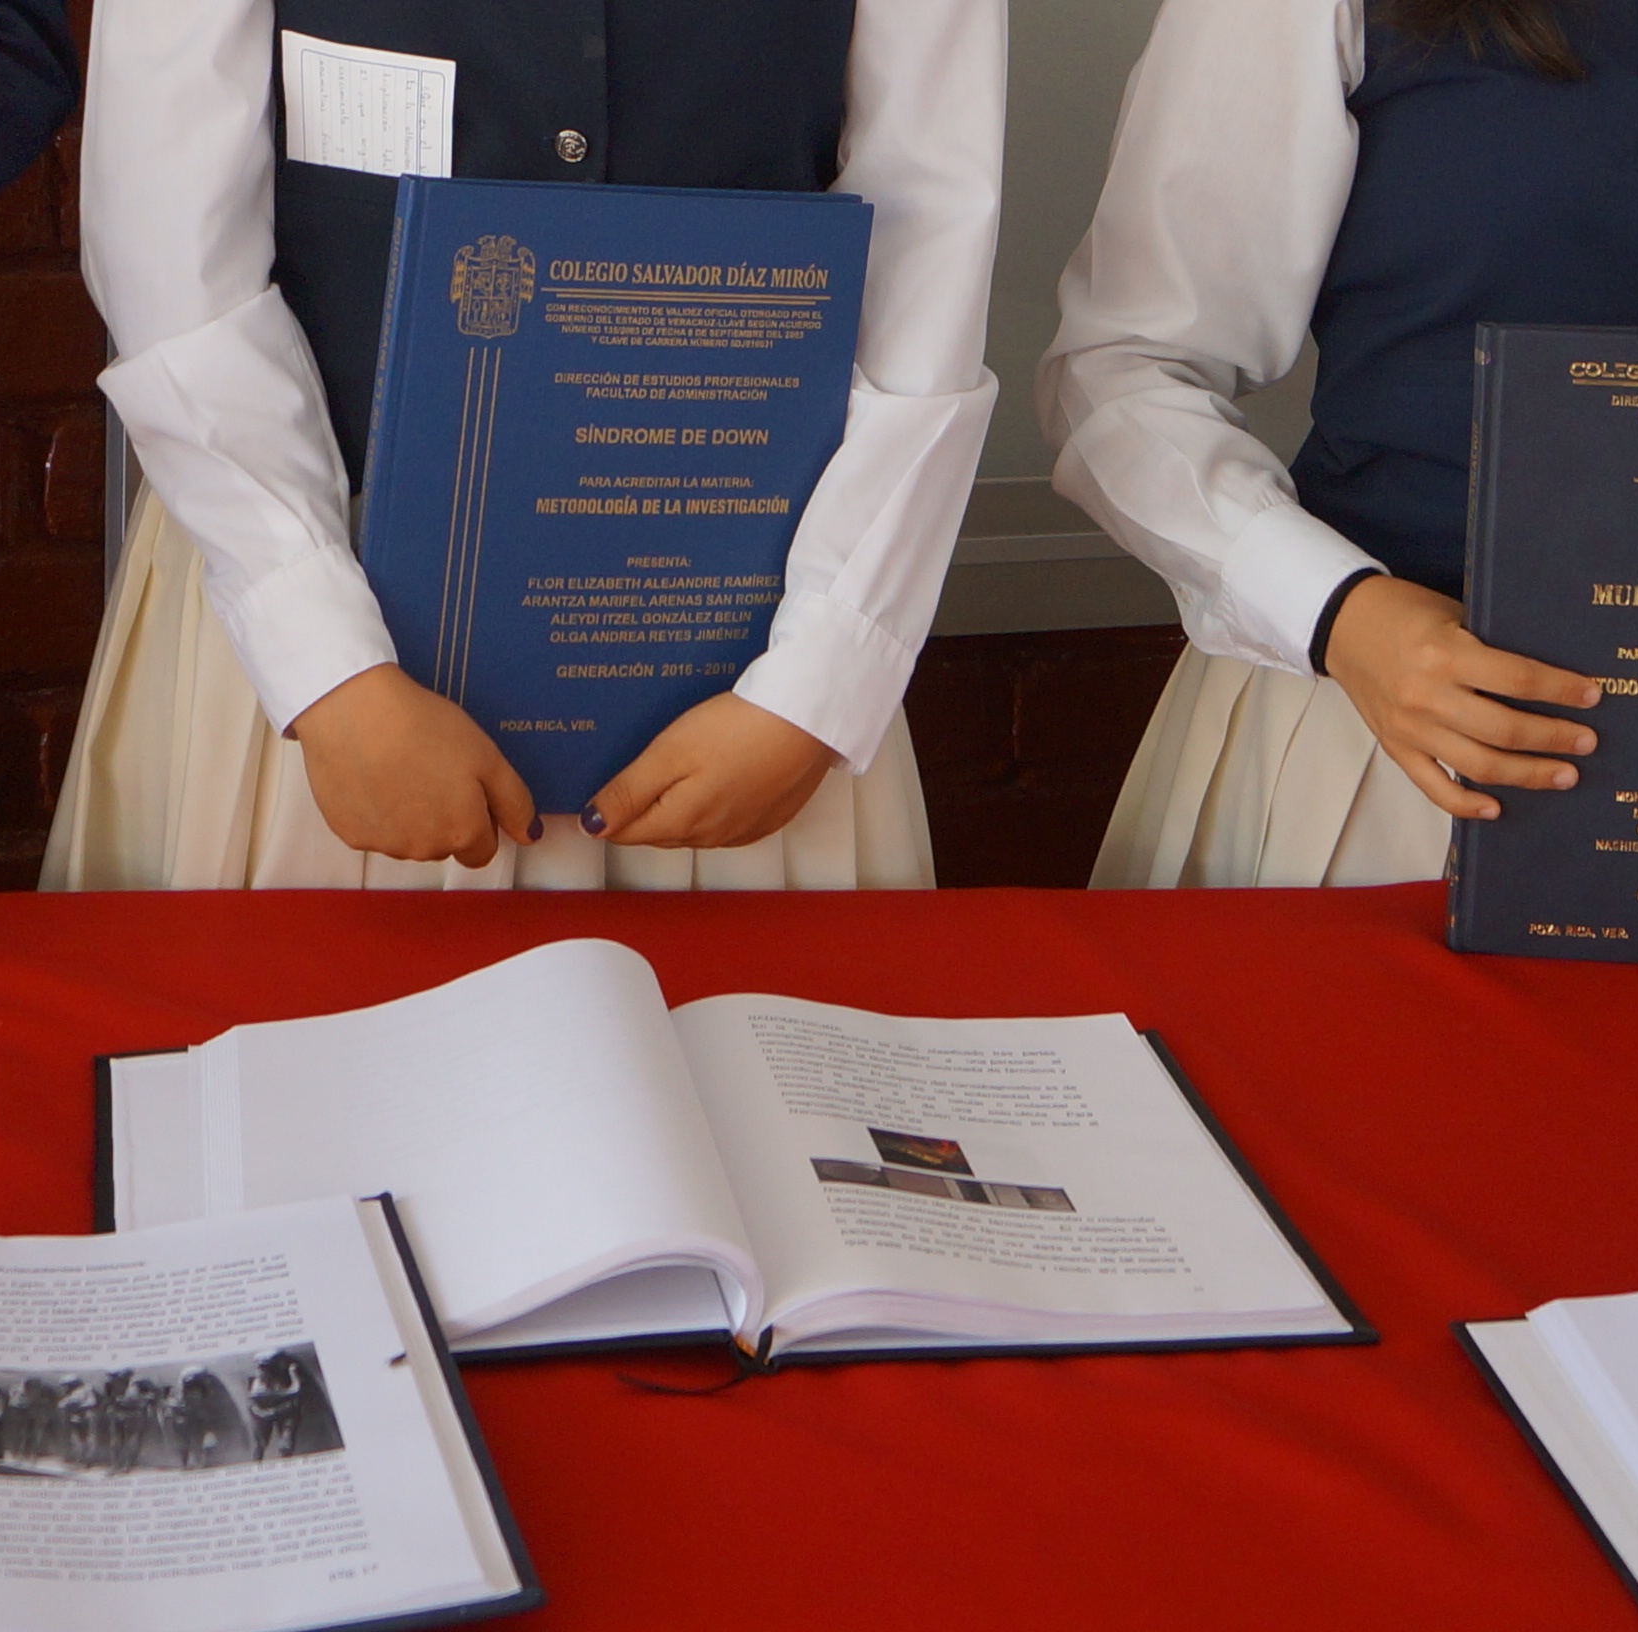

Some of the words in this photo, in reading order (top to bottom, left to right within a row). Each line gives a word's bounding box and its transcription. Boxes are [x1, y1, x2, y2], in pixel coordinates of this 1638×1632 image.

[549, 260, 625, 283] COLEGIO
[632, 264, 722, 286] SALVADOR
[726, 261, 766, 288] DÍAZ
[770, 264, 828, 290] MIRÓN
[555, 372, 620, 385] DIRECCIÓN
[624, 374, 640, 385] DE
[643, 374, 701, 386] ESTUDIOS
[705, 375, 799, 388] PROFESIONALES
[586, 387, 647, 399] FACULTAD
[650, 388, 664, 399] DE
[669, 388, 767, 400] ADMINISTRACIÓN
[575, 424, 675, 444] SÍNDROME
[681, 429, 707, 445] DE
[711, 429, 769, 446] DOWN
[579, 477, 611, 488] PARA
[614, 477, 680, 488] ACREDITAR
[684, 477, 698, 488] LA
[536, 495, 638, 515] METODOLOGÍA
[643, 498, 660, 515] DE
[665, 498, 682, 515] LA
[685, 496, 789, 515] INVESTIGACIÓN
[528, 577, 564, 588] FLOR
[568, 577, 641, 588] ELIZABETH
[644, 576, 721, 588] ALEJANDRE
[557, 663, 653, 678] GENERACIÓN
[662, 665, 693, 677] 2016
